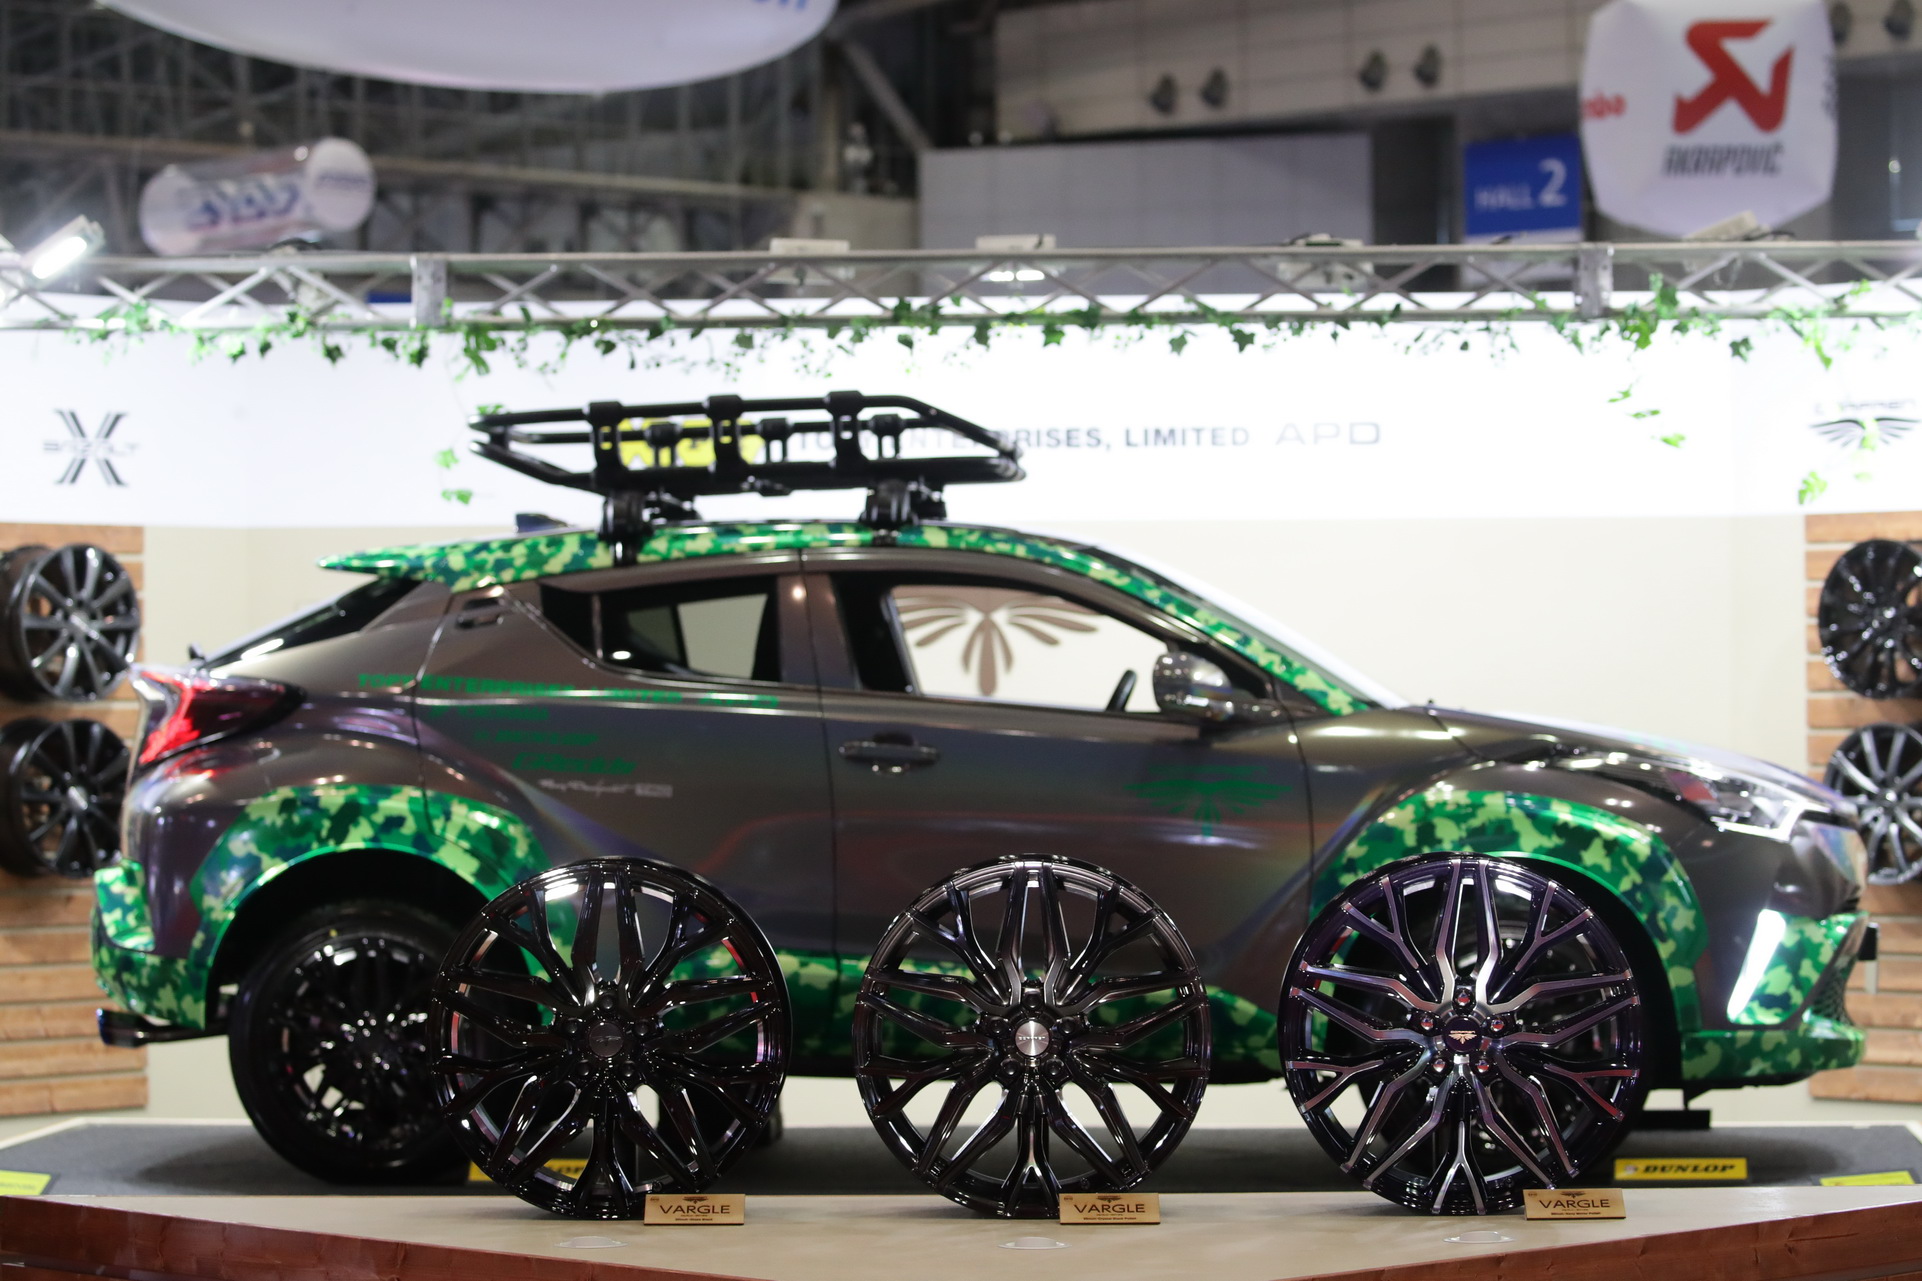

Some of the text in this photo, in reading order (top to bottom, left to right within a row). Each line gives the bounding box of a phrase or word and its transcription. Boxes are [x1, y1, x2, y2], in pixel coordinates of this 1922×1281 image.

[1538, 157, 1567, 207] 2
[1125, 427, 1249, 448] LIMITED
[1275, 422, 1381, 446] APD
[1643, 1163, 1736, 1174] DUNLOP
[659, 1204, 731, 1214] VARGLE
[1073, 1203, 1146, 1213] VARGLE
[1538, 1199, 1611, 1209] VARGLE
